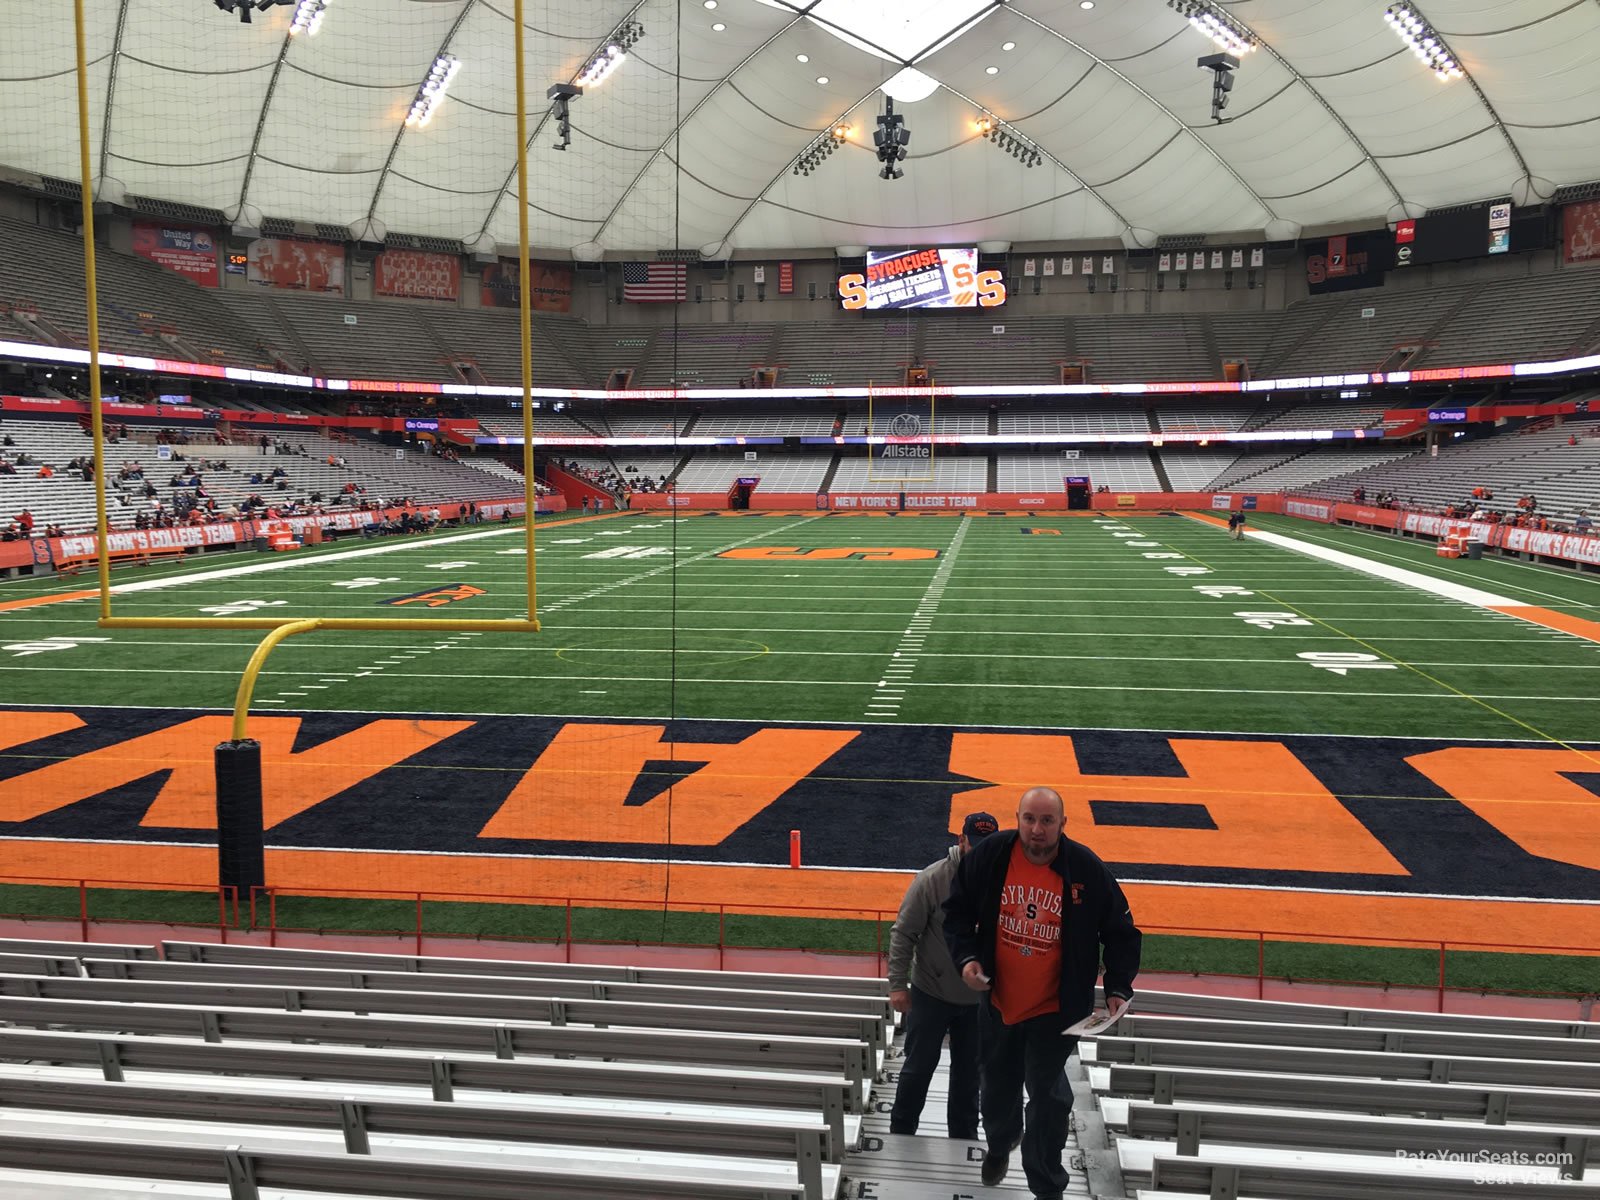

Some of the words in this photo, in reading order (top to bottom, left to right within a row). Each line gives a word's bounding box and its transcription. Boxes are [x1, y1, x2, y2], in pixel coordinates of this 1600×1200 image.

[162, 229, 191, 240] United
[174, 238, 192, 249] Way
[867, 249, 939, 281] SYRACUSE
[1333, 255, 1341, 265] 7
[838, 273, 868, 310] S
[888, 285, 916, 302] SALE
[976, 270, 1006, 307] S
[1411, 368, 1463, 381] SYRACUSE
[349, 380, 399, 392] SYRACUSE
[1429, 412, 1439, 420] Go
[1440, 411, 1465, 421] Orange
[406, 421, 416, 429] Go
[416, 421, 438, 430] Orange
[881, 445, 930, 458] Allstate
[835, 496, 858, 507] NEW
[859, 496, 898, 507] YORK'S
[947, 496, 977, 507] TEAM
[351, 511, 375, 527] TEAM
[1405, 513, 1420, 531] NEW
[1419, 515, 1441, 535] YORK'S
[60, 537, 96, 558] NEW
[149, 526, 203, 549] COLLEGE
[205, 523, 235, 545] TEAM
[1507, 528, 1530, 549] NEW
[1529, 531, 1563, 556] YORK'S
[33, 539, 50, 564] S
[1232, 611, 1314, 626] 20
[1295, 651, 1399, 670] 10
[1026, 902, 1038, 920] S
[999, 914, 1029, 935] FINAL
[1033, 923, 1061, 940] FOUR
[862, 1137, 885, 1152] D
[966, 1146, 988, 1162] D
